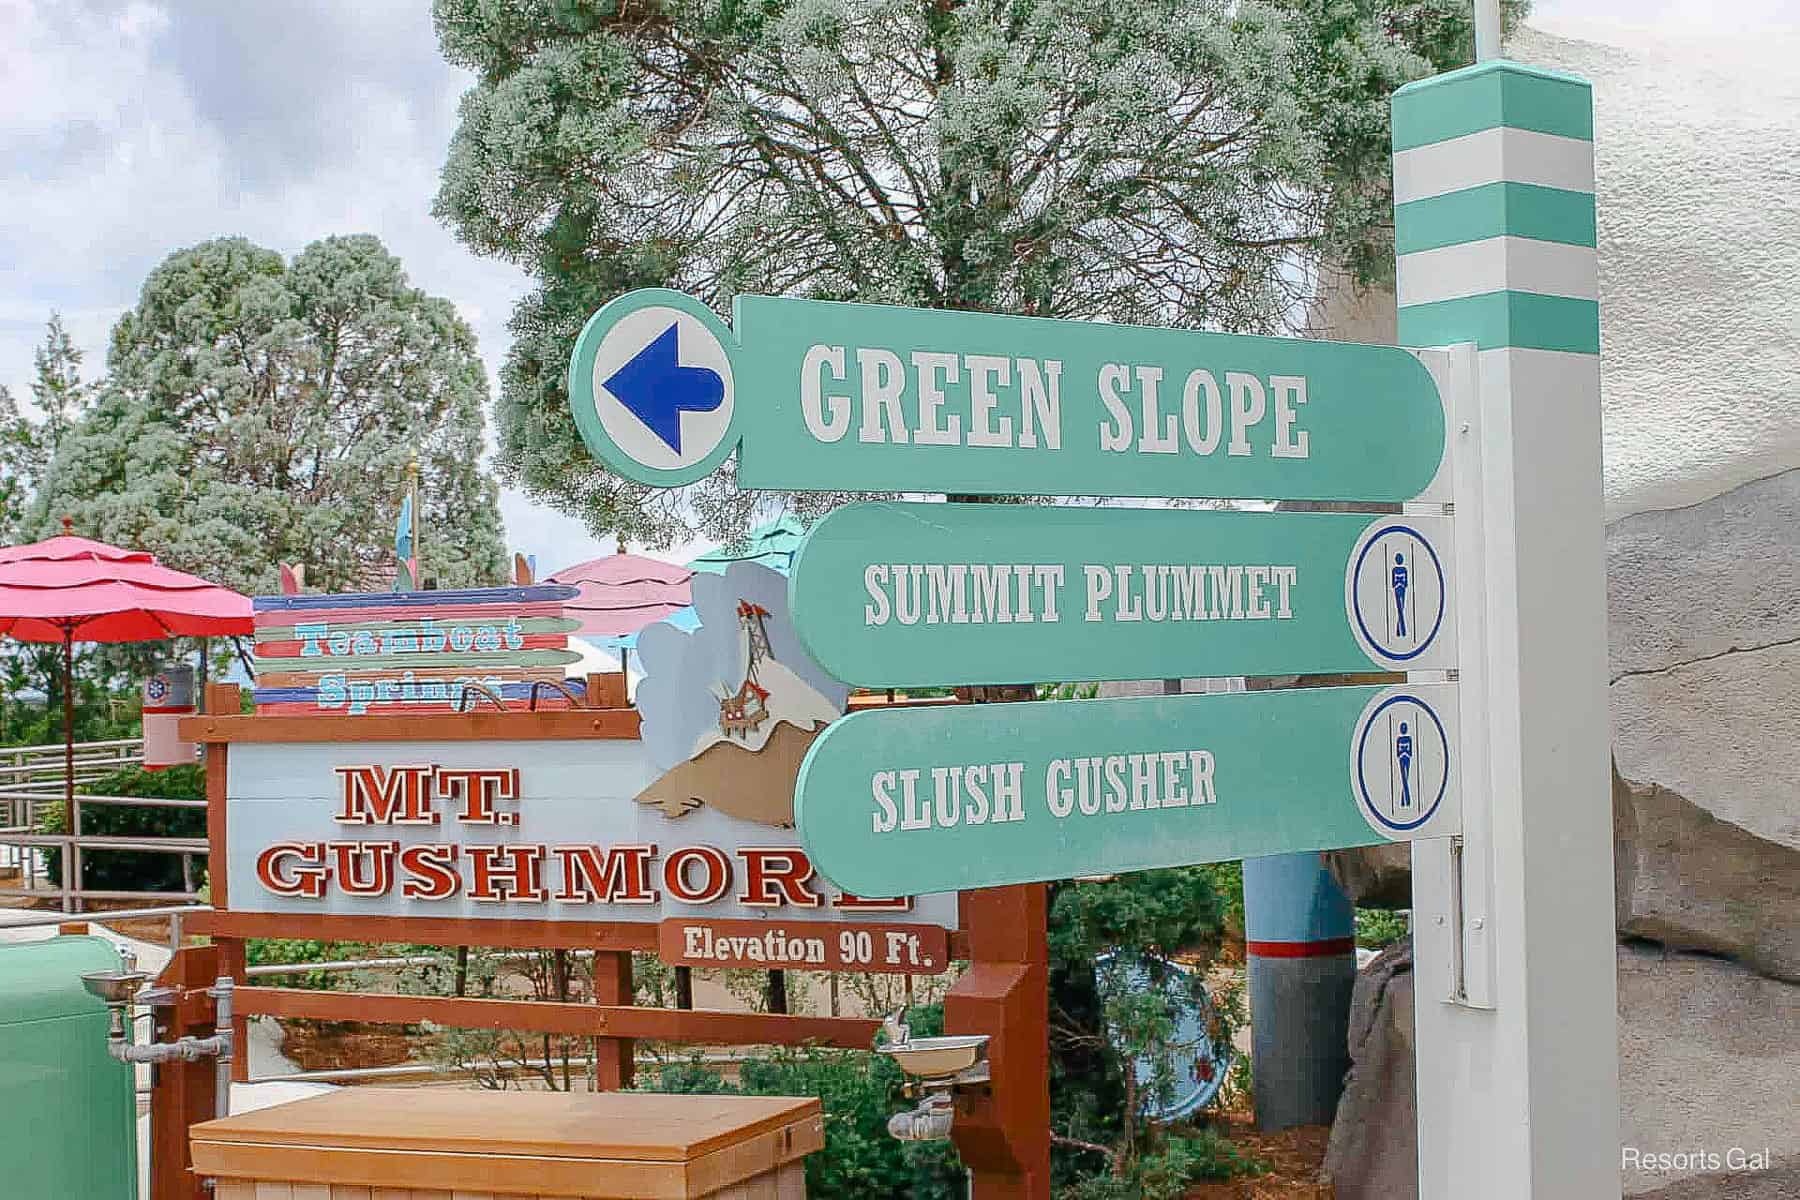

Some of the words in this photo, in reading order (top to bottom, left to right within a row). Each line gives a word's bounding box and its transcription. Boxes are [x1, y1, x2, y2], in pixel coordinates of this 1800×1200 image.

[800, 344, 1063, 450] GREEN
[1098, 363, 1309, 459] SLOPE
[864, 564, 1065, 625] SUMMIT
[1083, 565, 1297, 622] PLUMMET
[294, 617, 524, 657] Teamboat
[333, 764, 519, 826] MT.
[872, 763, 1025, 833] SLUSH
[1046, 750, 1216, 818] GUSHER
[256, 840, 915, 912] GUSHMOR
[683, 926, 825, 963] Elevation
[839, 931, 872, 963] 90
[885, 931, 934, 967] Ft.
